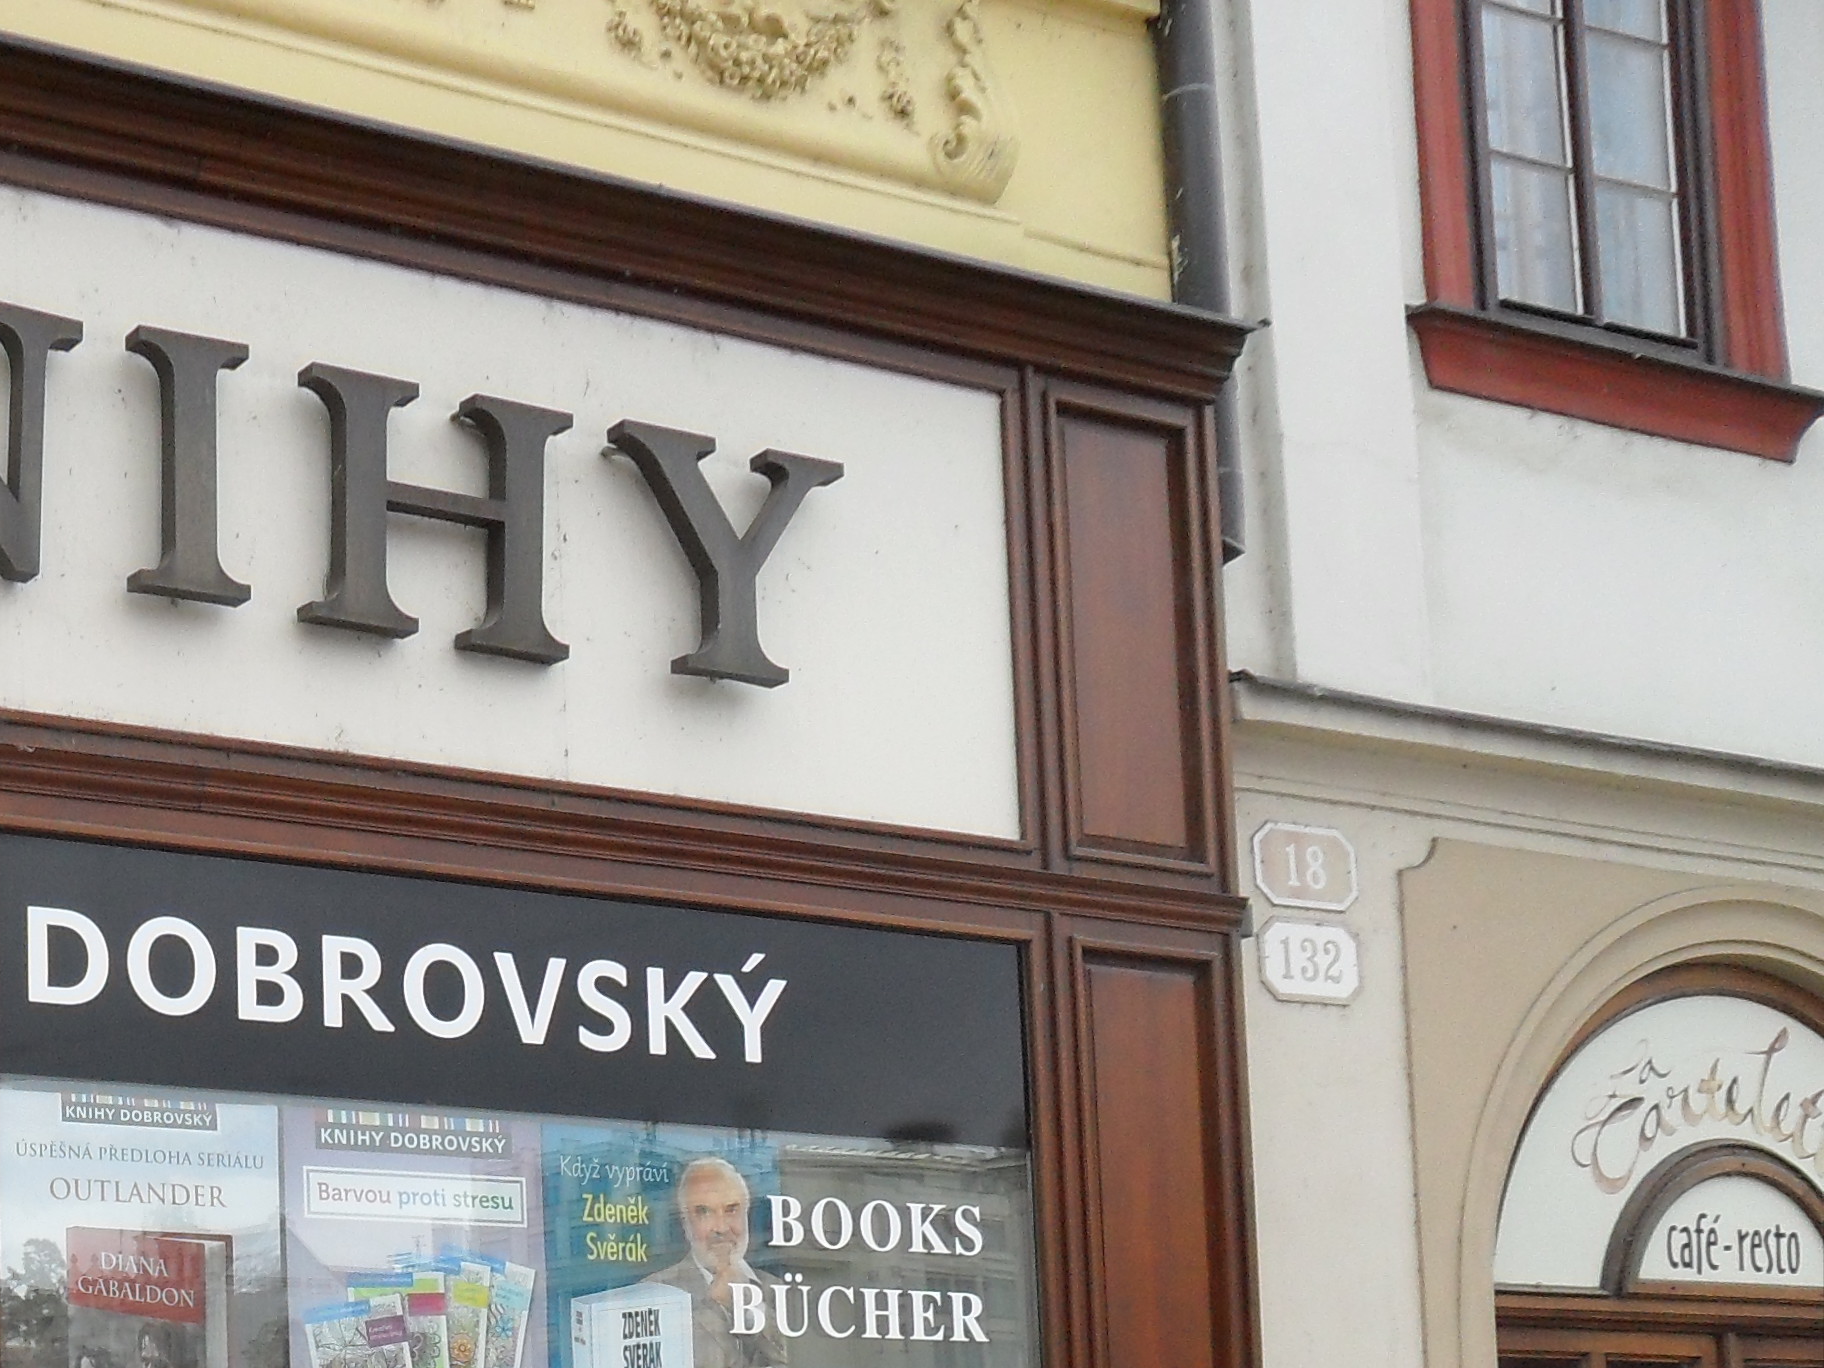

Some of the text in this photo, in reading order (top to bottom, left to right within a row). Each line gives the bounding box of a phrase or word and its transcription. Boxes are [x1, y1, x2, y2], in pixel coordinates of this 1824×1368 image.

[1284, 842, 1329, 890] 18
[1279, 936, 1344, 985] 132
[27, 904, 788, 1064] DOBROVSKÝ
[65, 1105, 213, 1127] KNIHY DOBROVSKÝ
[16, 1138, 265, 1170] ÚSPĚŠNÁ PŘEDLOHA SERIÁLU
[320, 1128, 506, 1154] KNIHY DOBROVSKÝ
[560, 1155, 670, 1188] Když vypráví
[49, 1176, 229, 1208] OUTLANDER
[317, 1181, 514, 1211] Barvou proti stresu
[581, 1193, 649, 1225] Zdeněk
[766, 1193, 984, 1257] BOOKS
[586, 1231, 648, 1262] Svěrák
[101, 1251, 169, 1277] DIANA
[77, 1276, 195, 1308] GABALDON
[728, 1272, 990, 1343] BÜCHER
